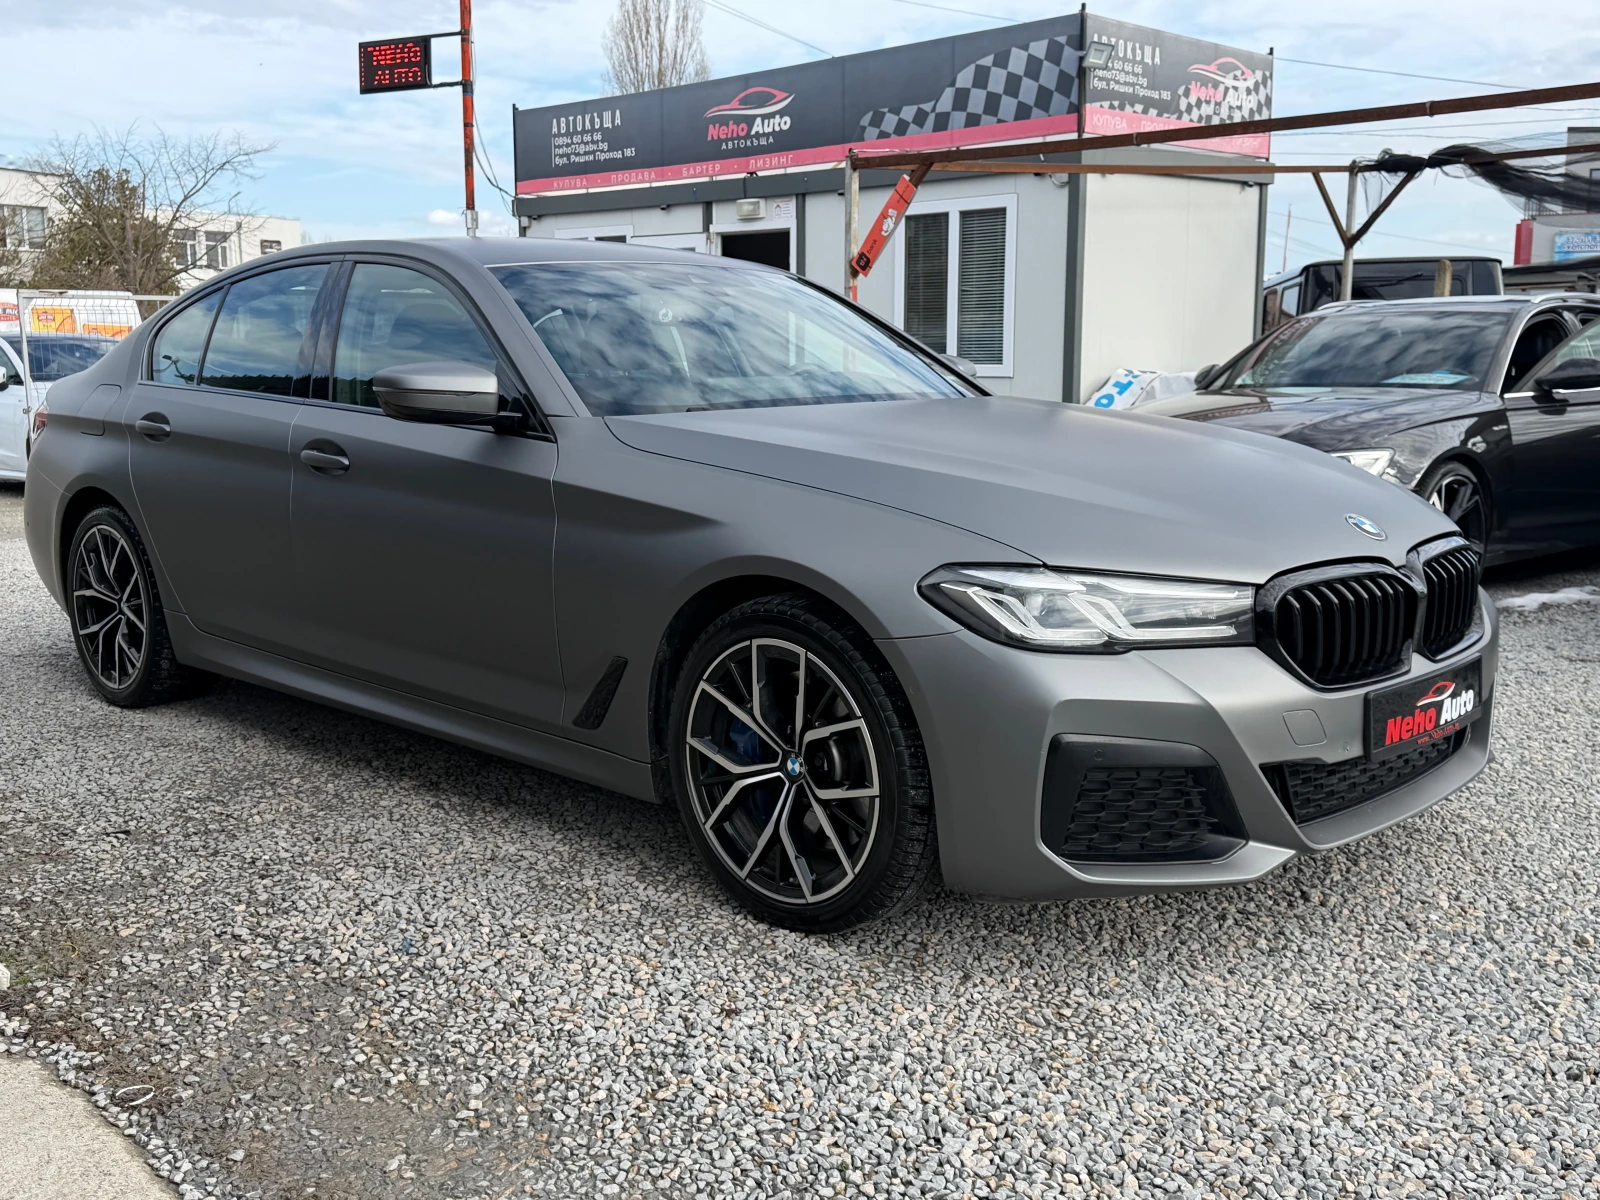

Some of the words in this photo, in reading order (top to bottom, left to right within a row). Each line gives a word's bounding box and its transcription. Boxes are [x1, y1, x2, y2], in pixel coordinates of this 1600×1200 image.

[1113, 60, 1123, 70] 60
[1123, 62, 1133, 73] 66
[1134, 64, 1143, 74] 66
[1160, 90, 1171, 100] 183
[1190, 81, 1222, 102] Neho
[1225, 88, 1253, 108] Auto
[551, 109, 621, 134] АВТОКЪЩА
[707, 120, 748, 141] Neho
[750, 114, 791, 135] Auto
[1093, 114, 1127, 130] КУПУВА
[554, 136, 571, 145] 0894
[573, 135, 581, 144] 60
[583, 133, 592, 142] 66
[593, 132, 602, 141] 66
[721, 135, 774, 150] АВТОКЪЩА
[555, 142, 608, 154] neho73@abv.bg
[555, 155, 569, 166] бул.
[570, 154, 594, 163] Ришки
[595, 150, 622, 162] Проход
[623, 147, 636, 157] 183
[553, 178, 587, 189] КУПУВА
[610, 171, 656, 183] ПРОДАВА
[682, 164, 721, 177] БАРТЕР
[749, 155, 794, 169] ЛИЗИНГ
[1385, 707, 1437, 746] Neho
[1440, 689, 1474, 725] Auto
